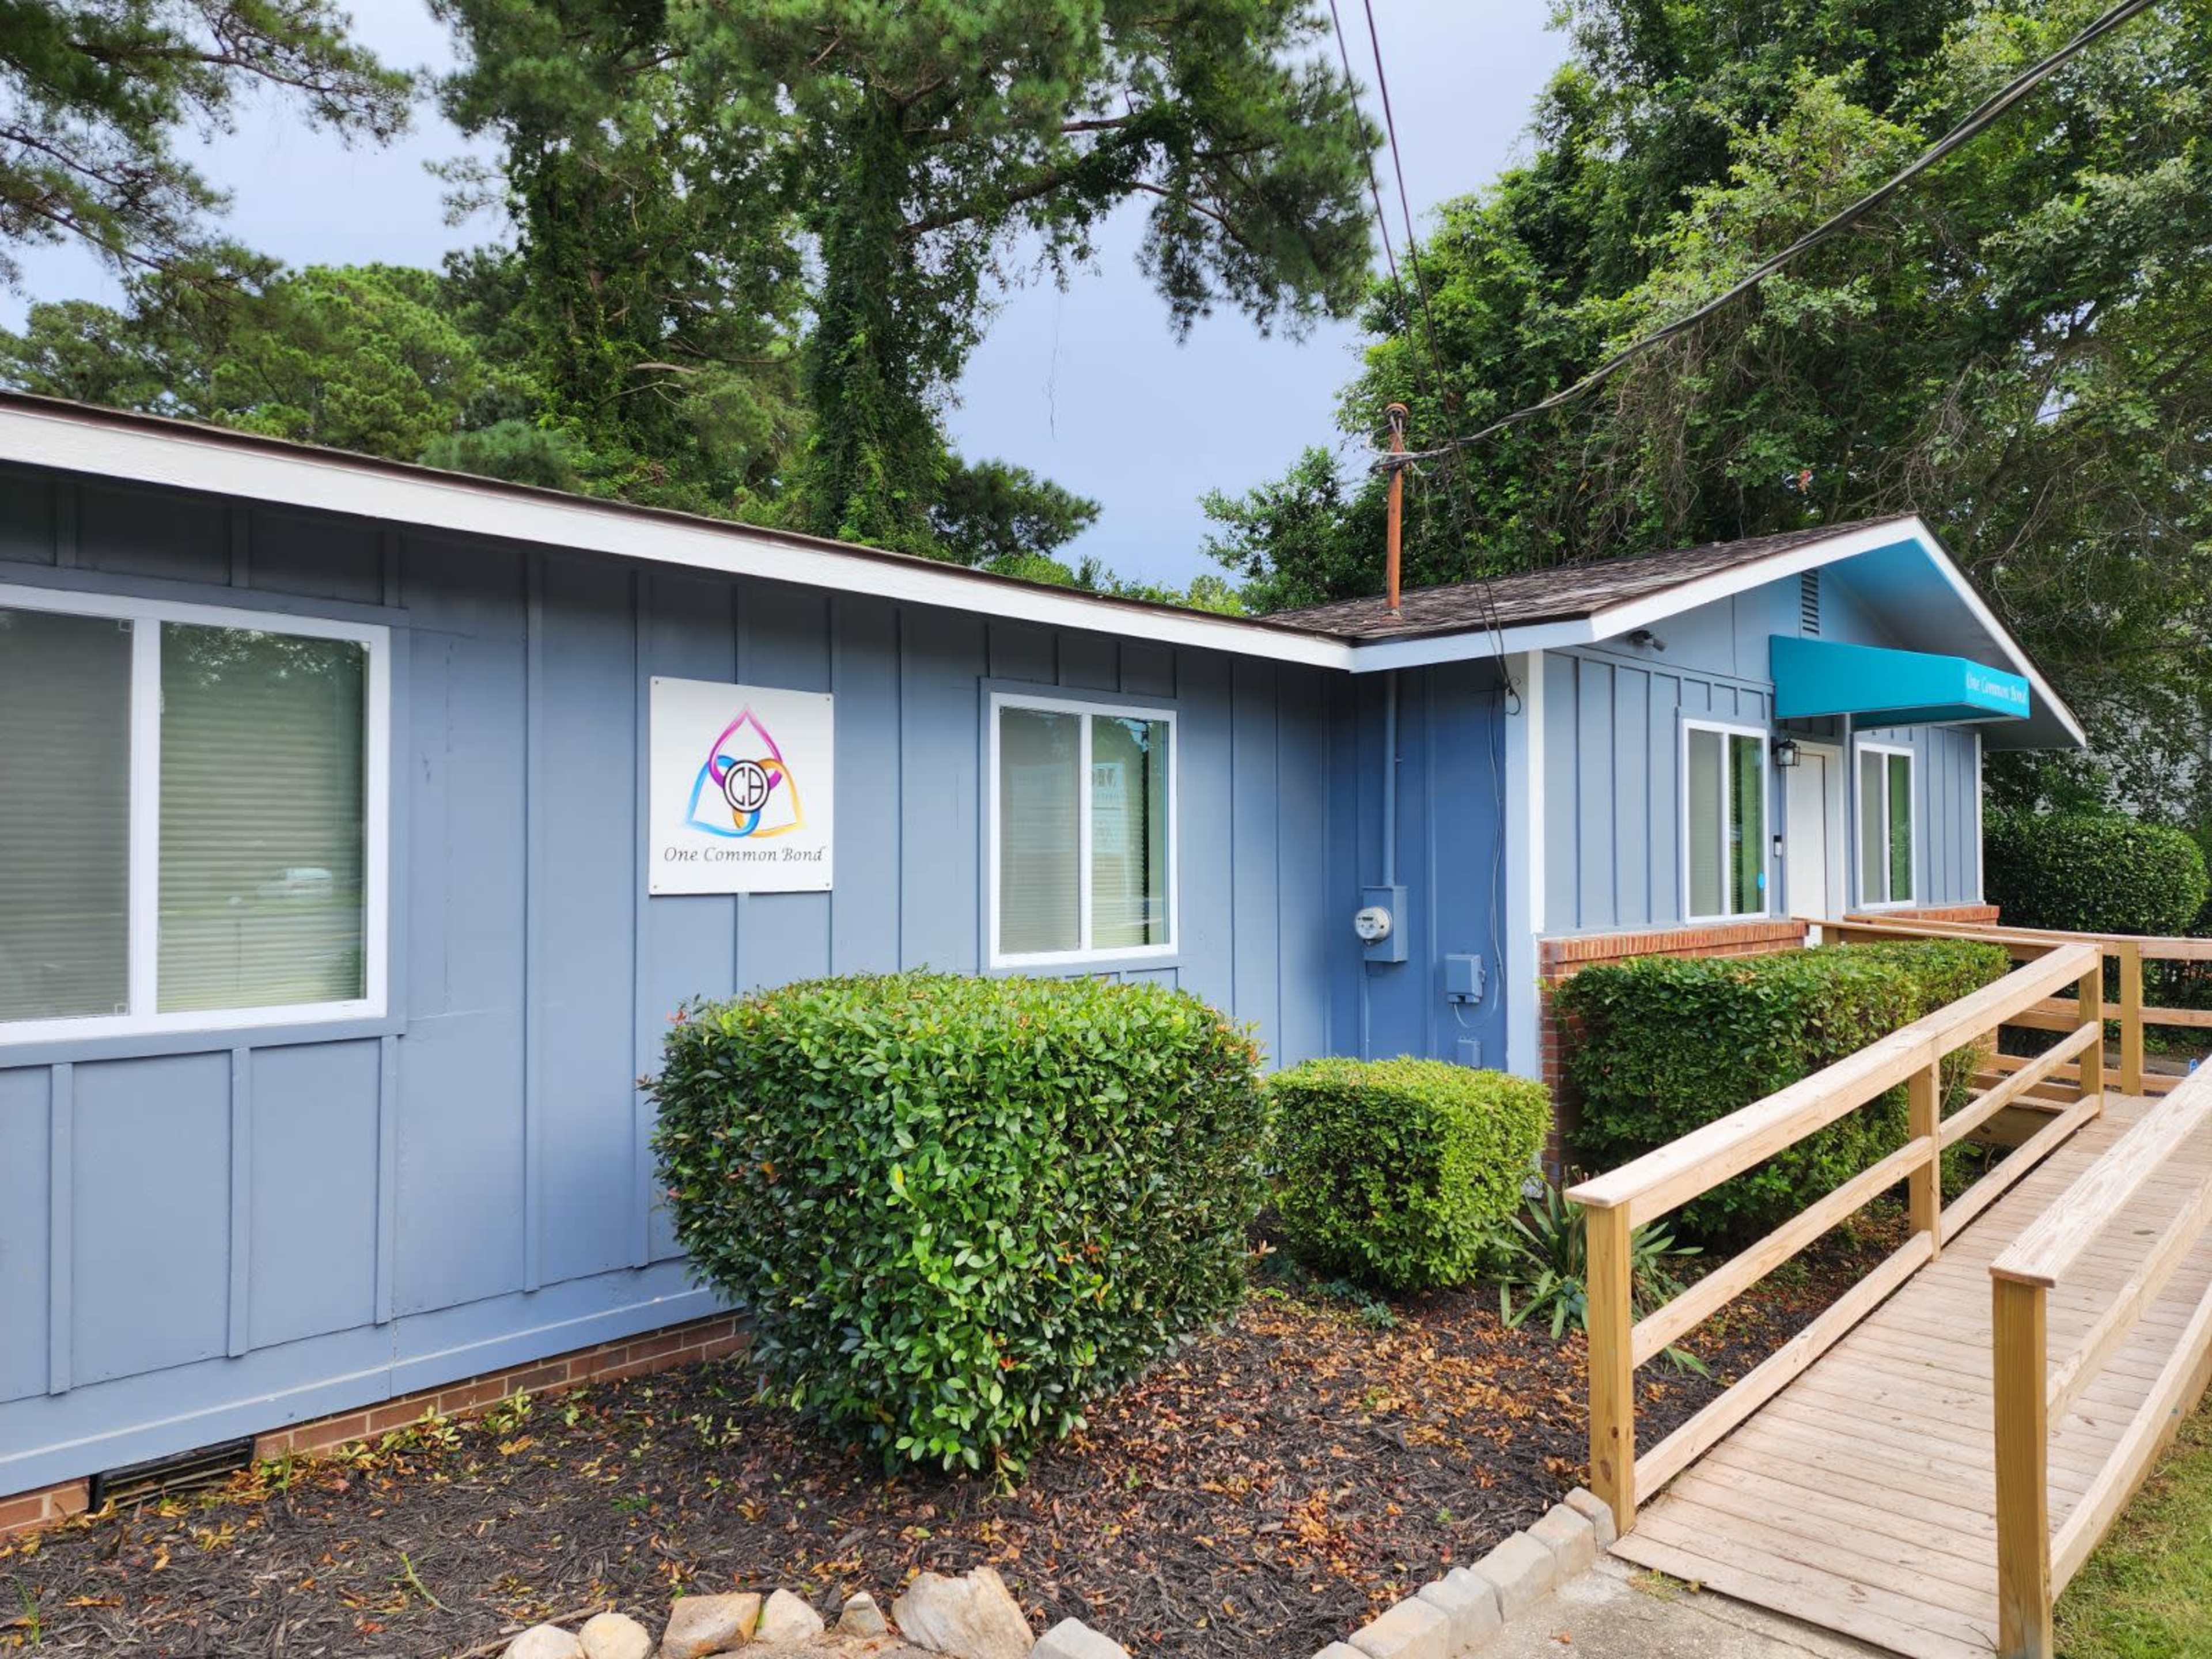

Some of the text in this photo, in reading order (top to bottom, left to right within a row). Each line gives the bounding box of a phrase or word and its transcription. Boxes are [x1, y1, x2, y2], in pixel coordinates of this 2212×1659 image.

[664, 846, 826, 862] One Common Bond
